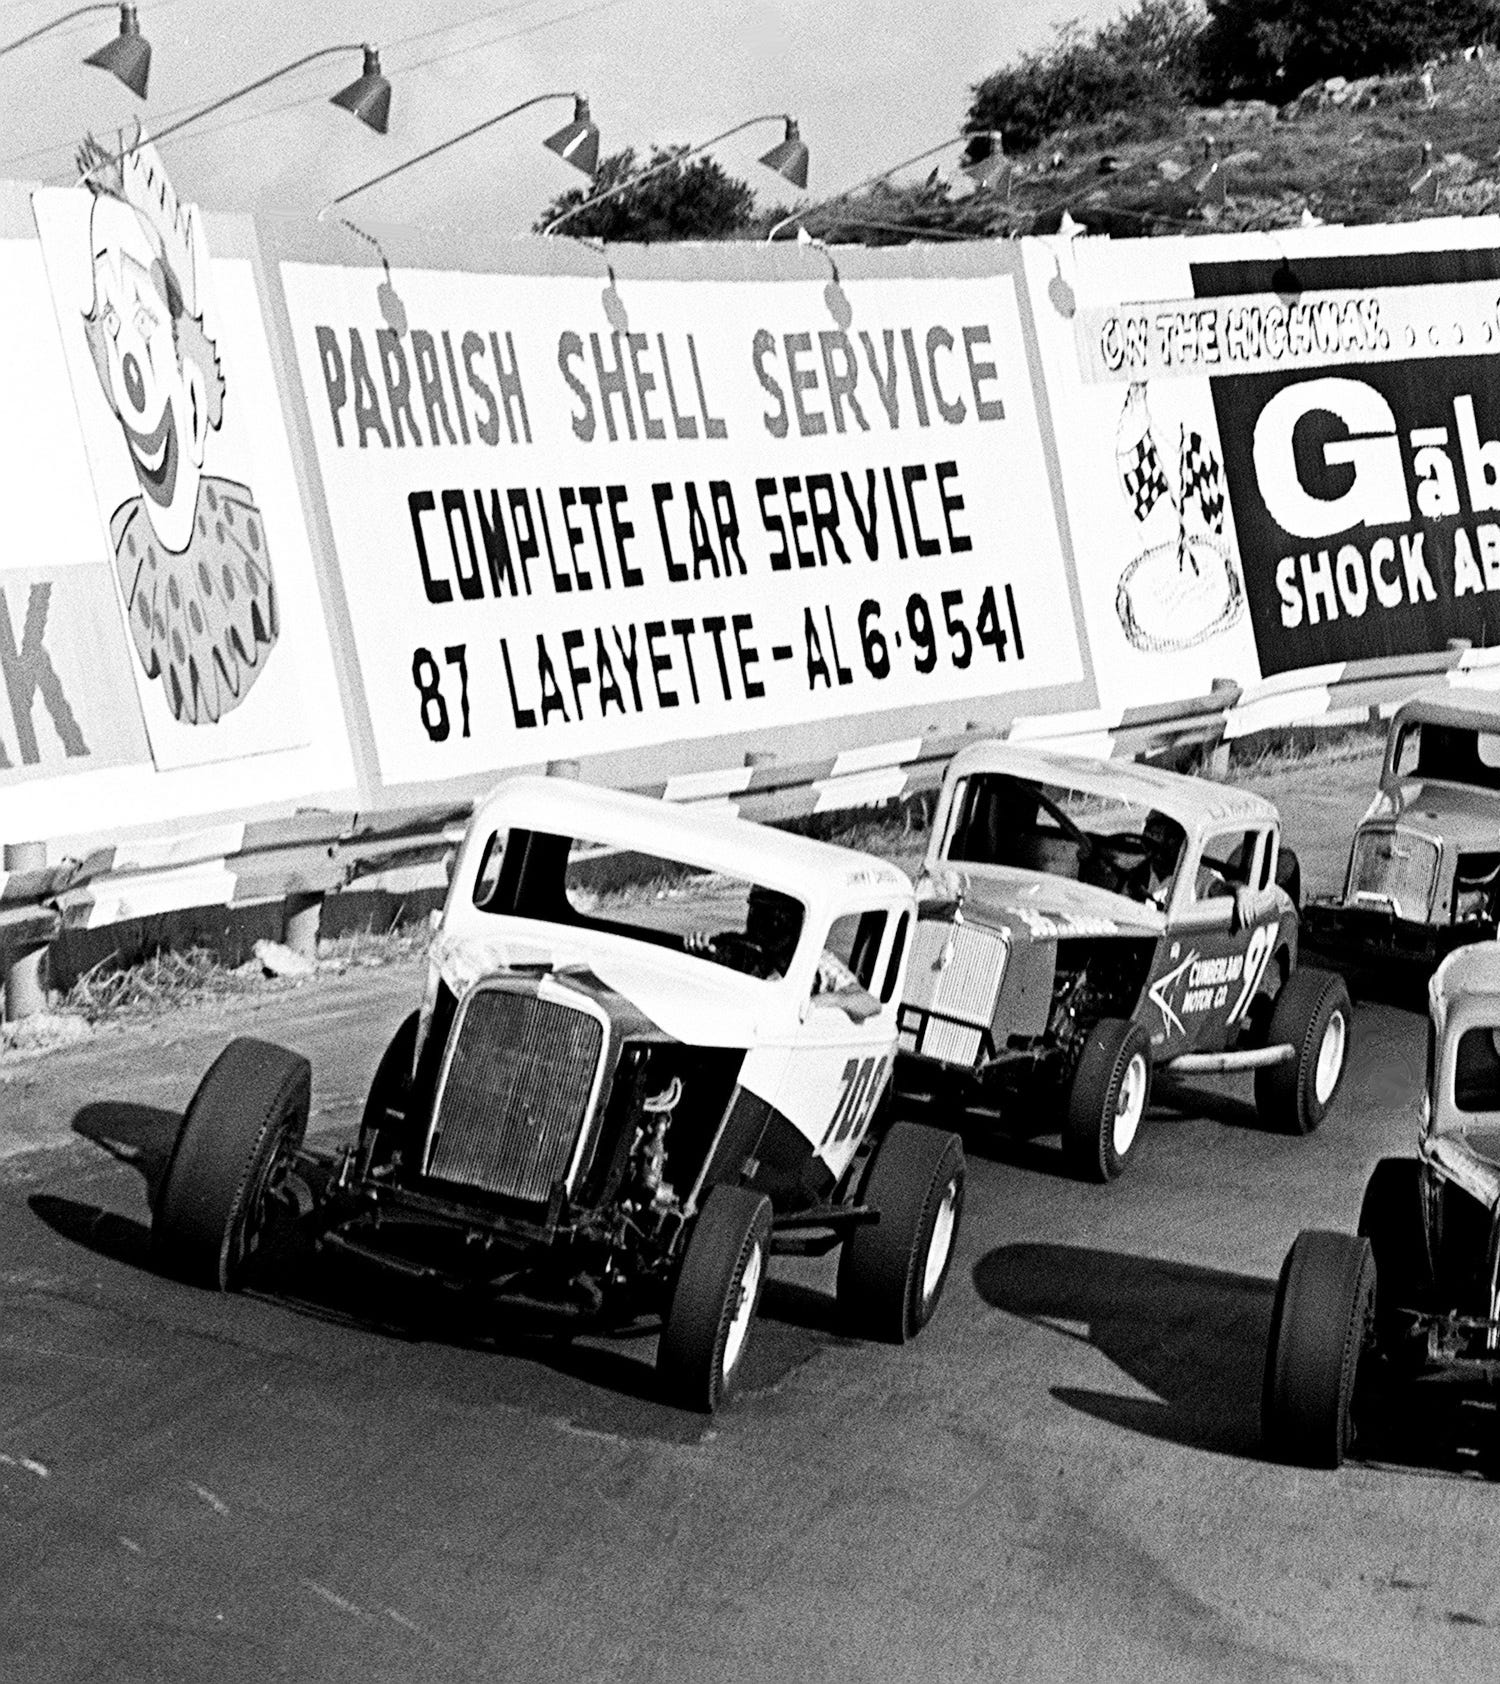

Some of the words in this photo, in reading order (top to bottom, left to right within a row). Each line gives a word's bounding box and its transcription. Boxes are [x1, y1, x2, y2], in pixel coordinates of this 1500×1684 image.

[315, 325, 532, 448] PARRISH
[557, 330, 728, 443] SHELL
[752, 325, 1005, 439] SERVICE
[1101, 317, 1147, 370] ON
[1156, 310, 1220, 366] THE
[407, 485, 644, 604] COMPLETE
[651, 480, 747, 582] CAR
[755, 460, 973, 571] SERVICE
[1276, 533, 1438, 628] SHOCK
[0, 582, 91, 768] K
[411, 644, 471, 742] 87
